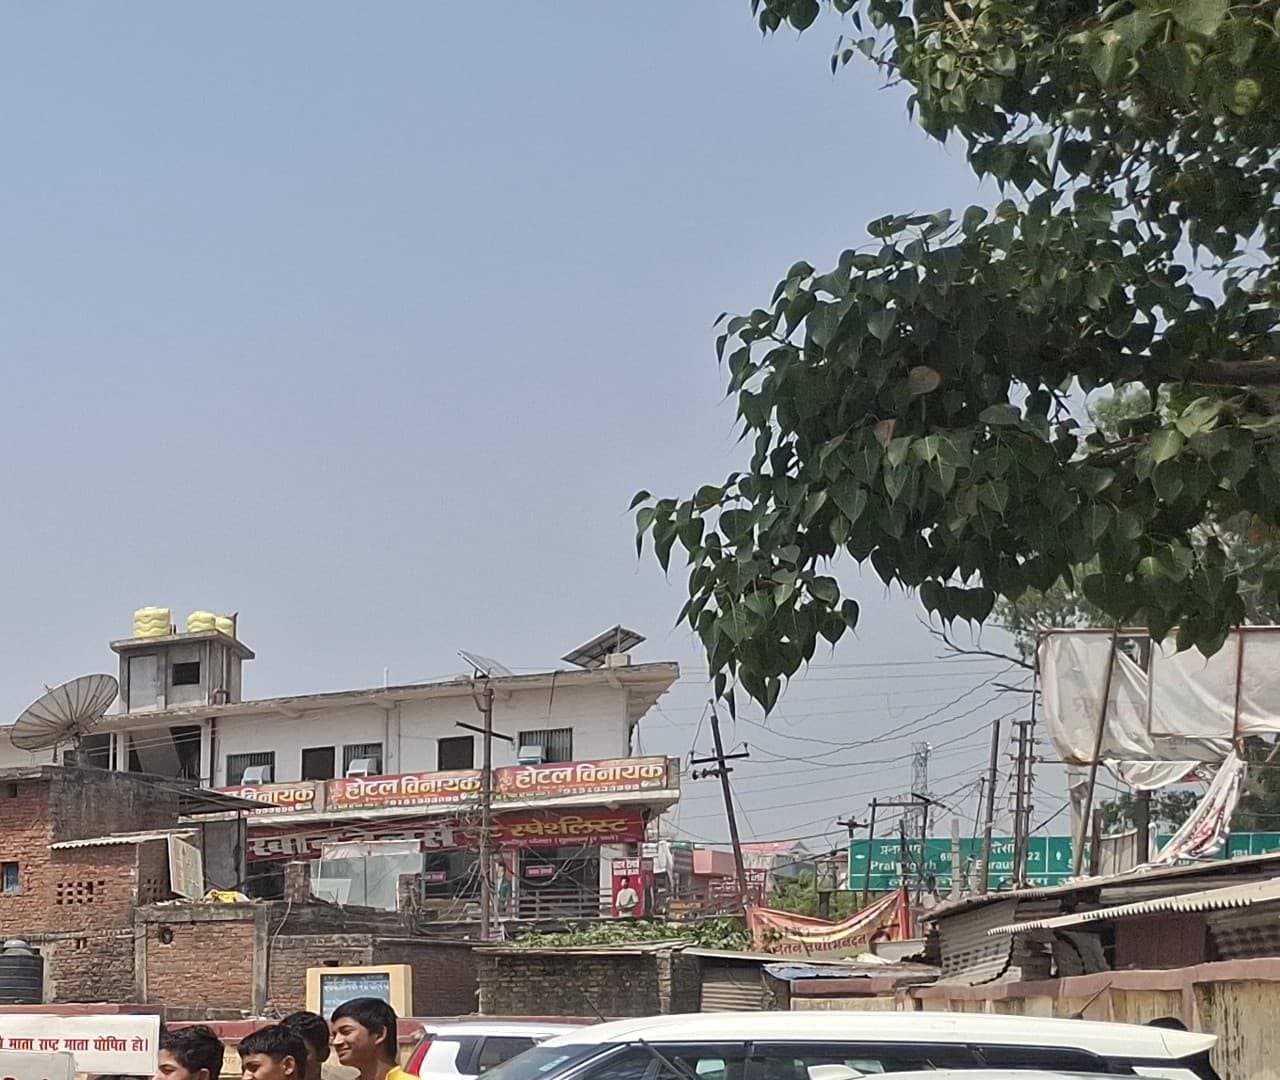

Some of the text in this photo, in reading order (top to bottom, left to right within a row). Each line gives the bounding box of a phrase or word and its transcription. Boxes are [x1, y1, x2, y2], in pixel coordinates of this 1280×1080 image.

[515, 763, 665, 788] होटल विनायक
[345, 778, 398, 799] होटल
[401, 776, 483, 795] विनायक
[8, 1038, 34, 1050] माता
[64, 1038, 89, 1051] माता
[93, 1036, 127, 1051] घोषित
